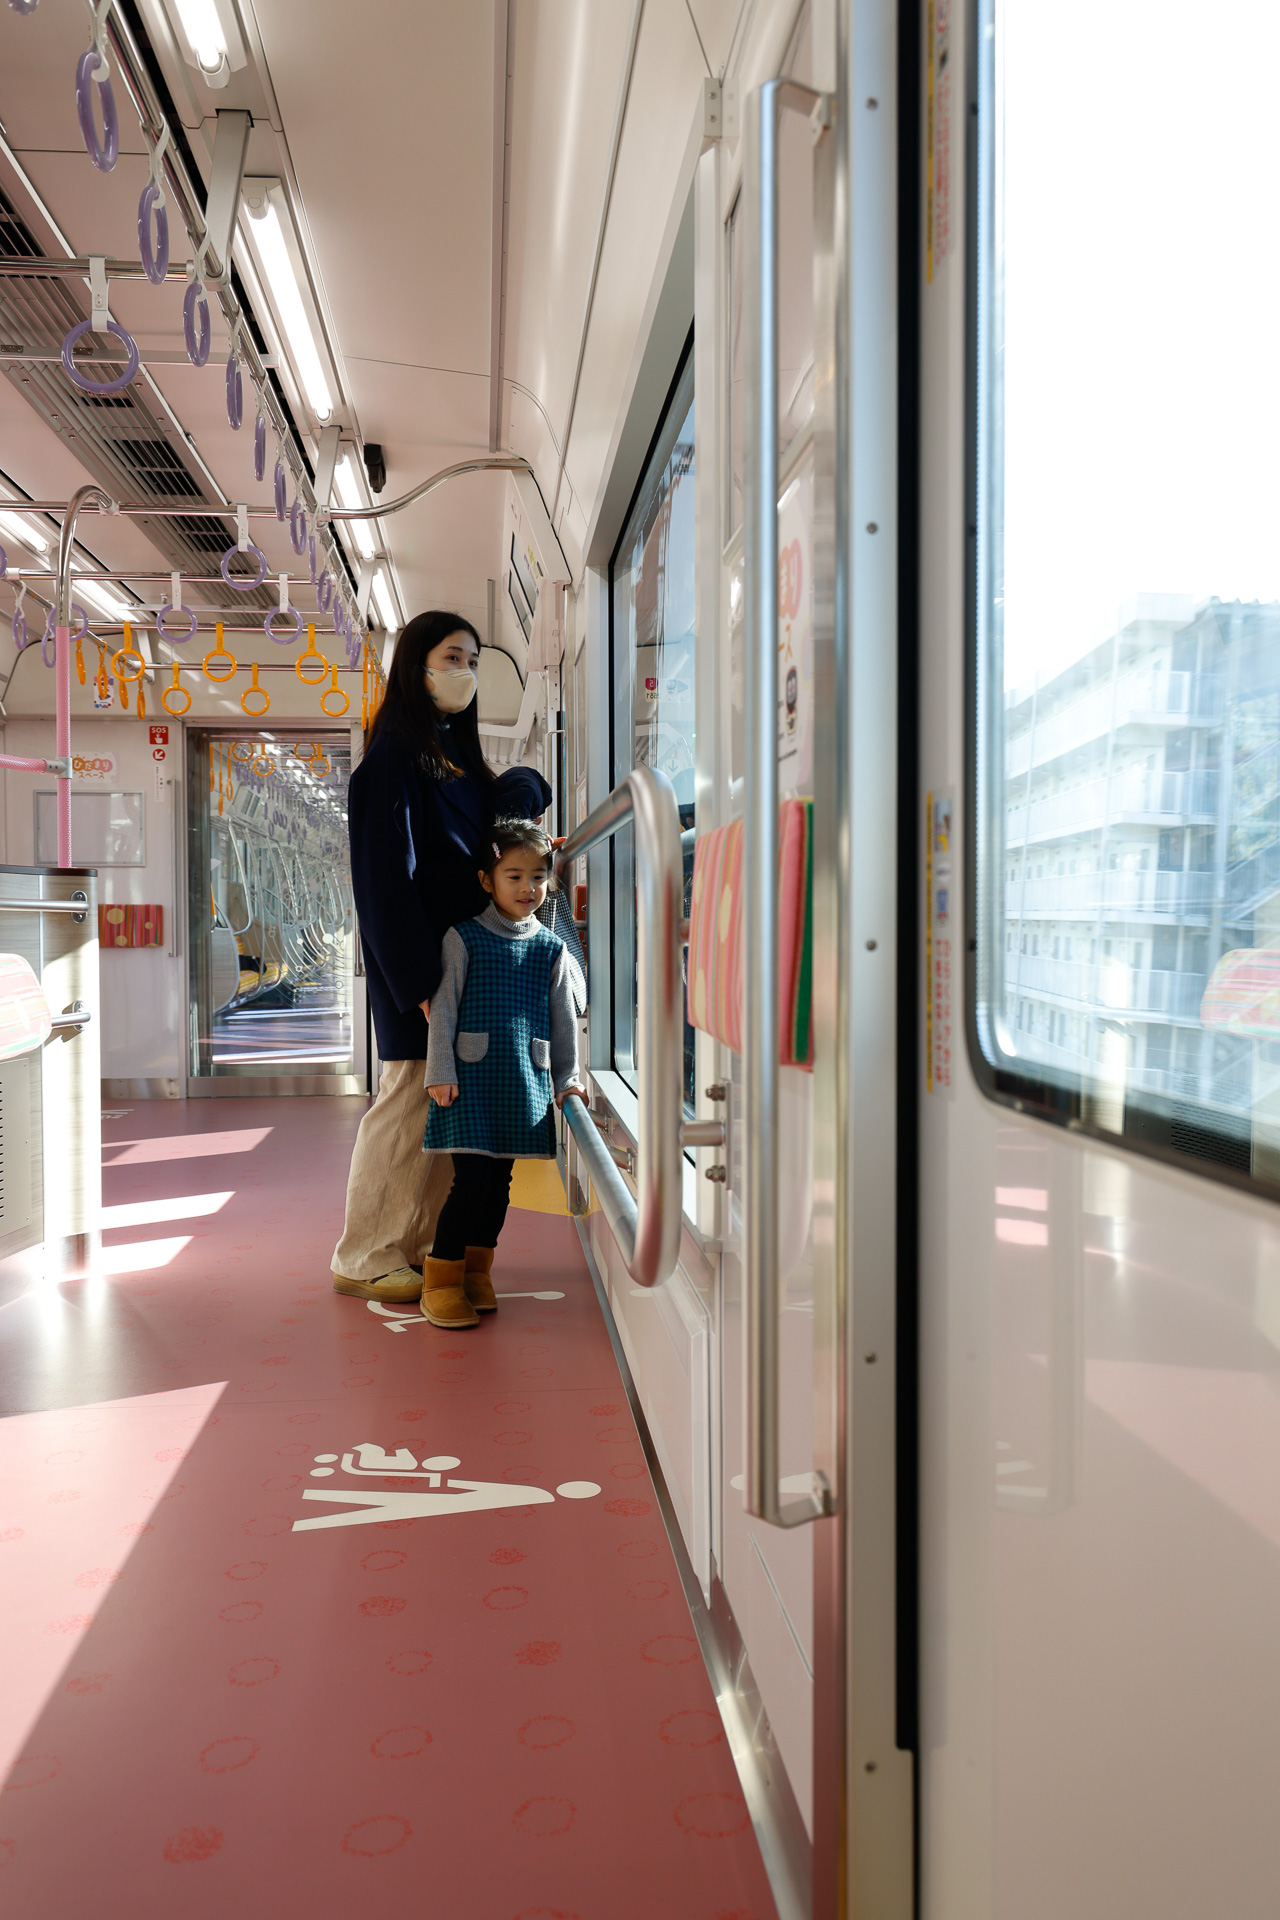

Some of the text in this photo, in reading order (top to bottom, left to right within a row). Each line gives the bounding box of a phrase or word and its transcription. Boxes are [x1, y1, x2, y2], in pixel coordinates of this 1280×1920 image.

[73, 760, 109, 770] ひだまり
[78, 771, 105, 779] スペース
